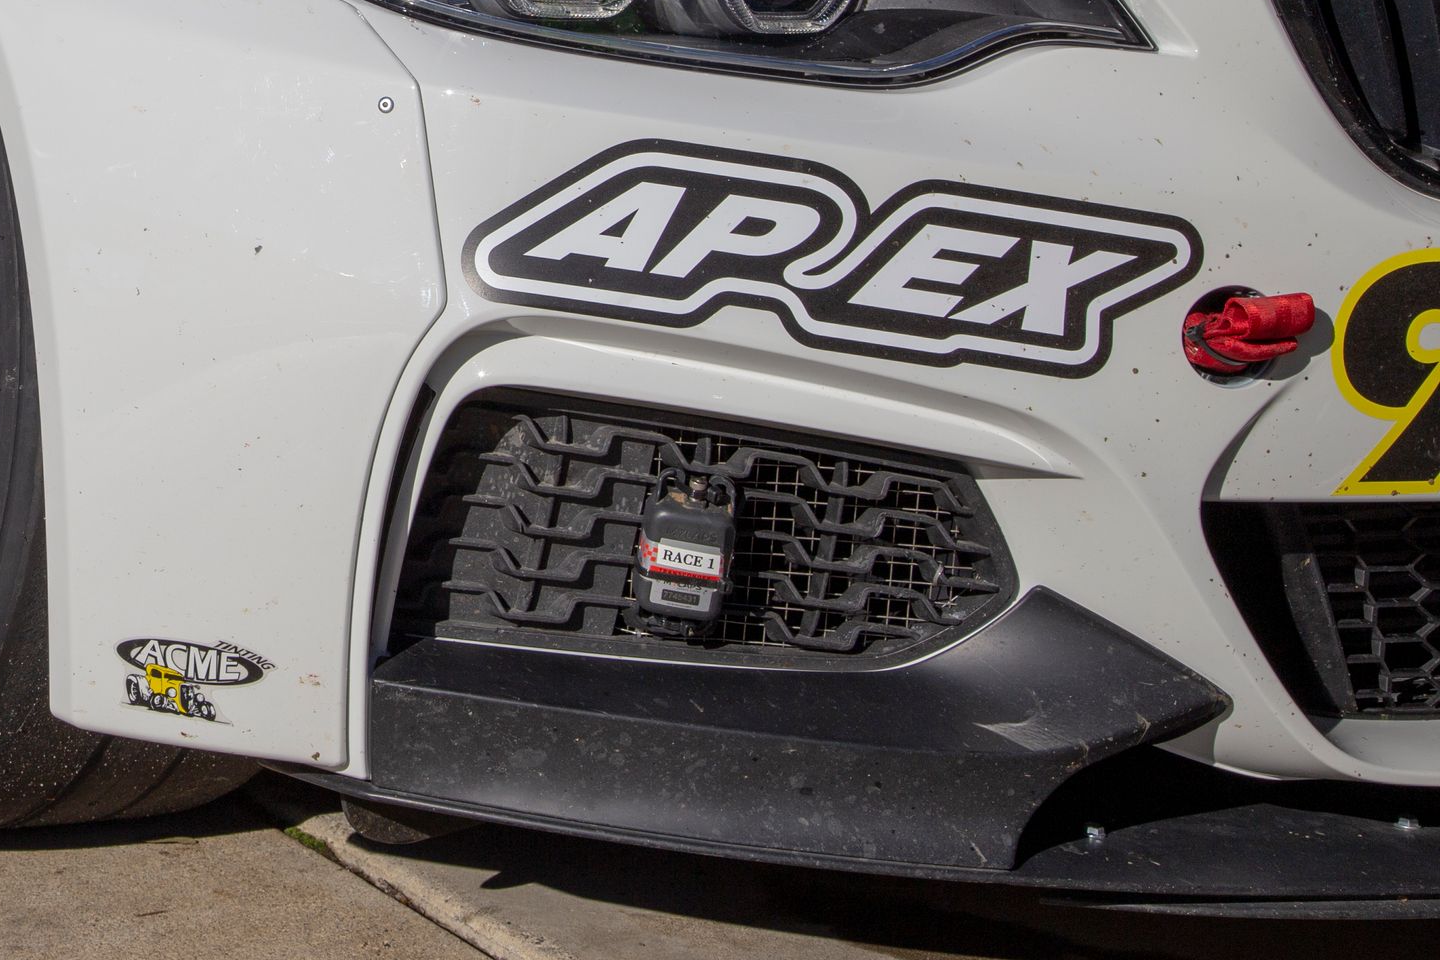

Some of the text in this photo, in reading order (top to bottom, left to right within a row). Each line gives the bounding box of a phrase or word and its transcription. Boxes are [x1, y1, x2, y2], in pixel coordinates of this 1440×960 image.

[523, 180, 1138, 337] APEX
[663, 549, 715, 570] RACE 1
[134, 640, 241, 681] ACME
[213, 640, 276, 670] TINTING
